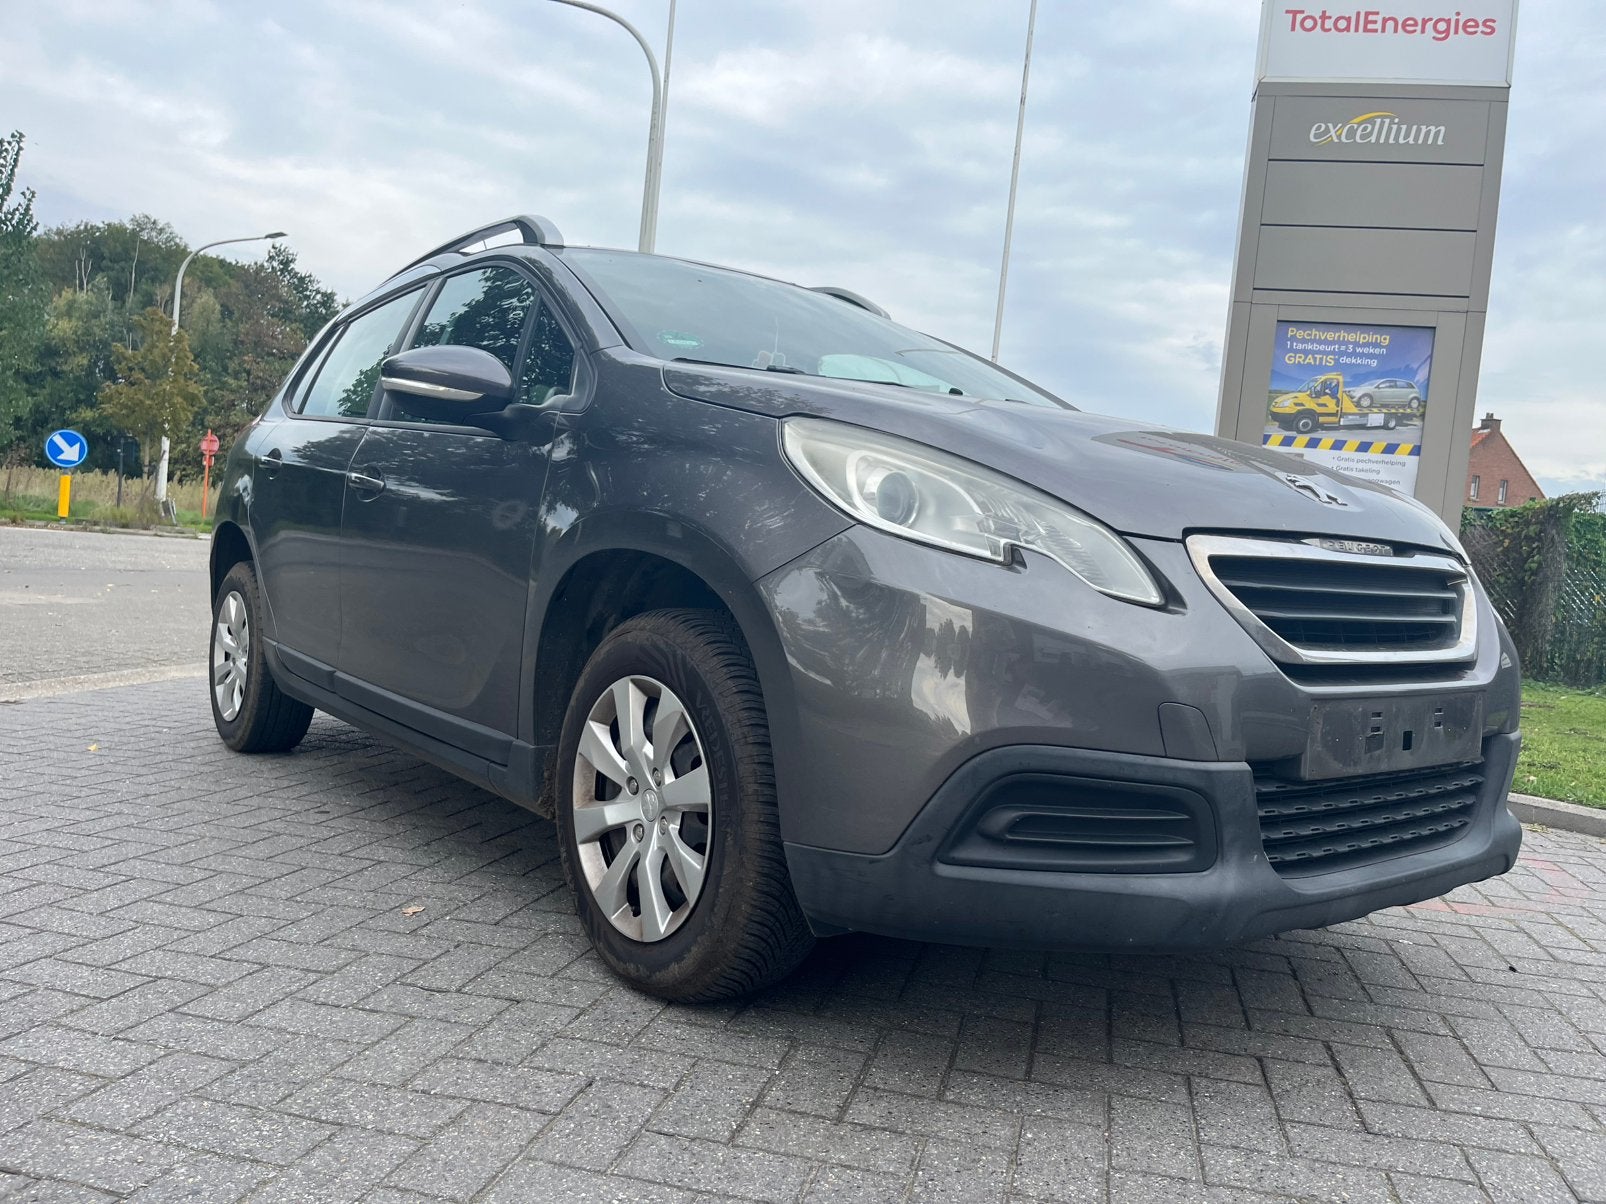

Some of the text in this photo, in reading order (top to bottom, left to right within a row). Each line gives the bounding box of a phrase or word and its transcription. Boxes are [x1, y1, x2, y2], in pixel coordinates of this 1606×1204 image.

[1285, 9, 1497, 42] TotalEnergies
[1309, 117, 1446, 146] excellium
[1288, 327, 1390, 345] Pechverhelping
[1293, 342, 1339, 352] tankbeurt
[1347, 344, 1354, 353] 3
[1355, 345, 1387, 355] weken
[1339, 355, 1378, 367] dekking
[1336, 455, 1407, 467] Gratis pechverhelping
[1335, 465, 1381, 475] Gratis takeling
[1327, 540, 1386, 554] PEUGEOT
